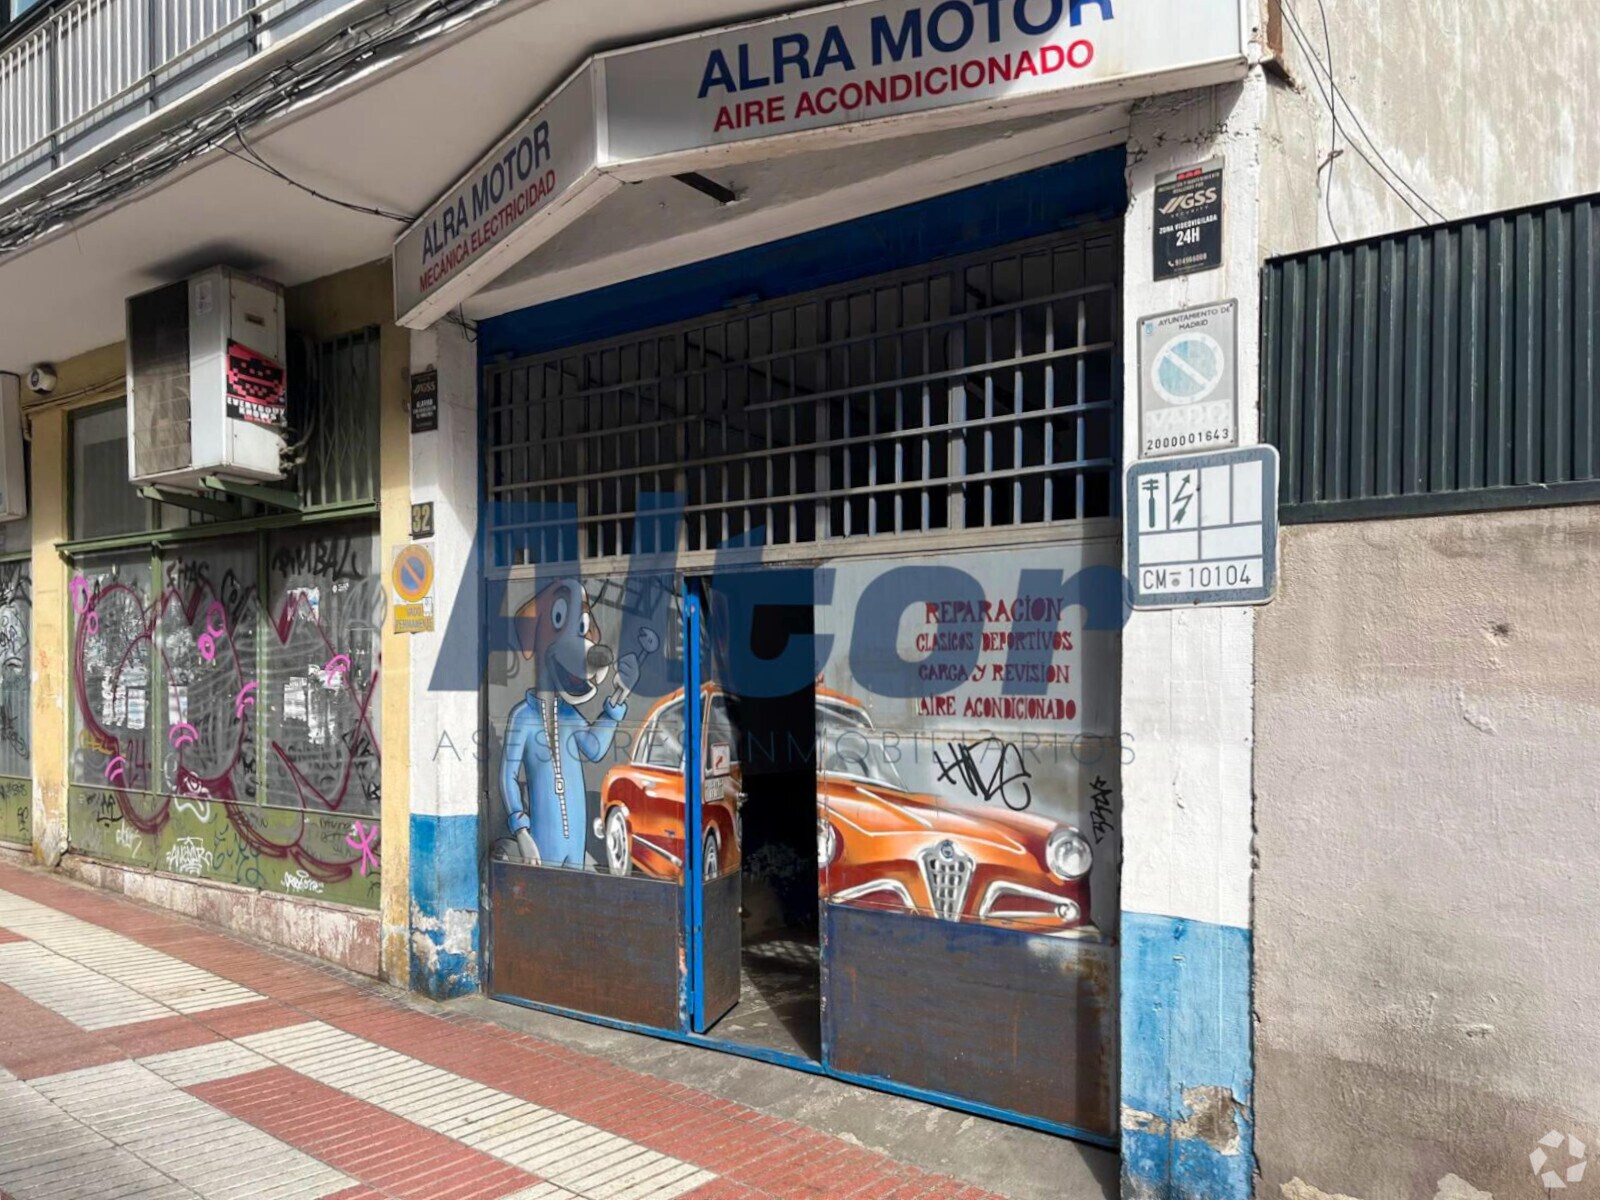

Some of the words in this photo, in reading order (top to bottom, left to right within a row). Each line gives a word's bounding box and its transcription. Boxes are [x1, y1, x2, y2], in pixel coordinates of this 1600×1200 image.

[697, 25, 855, 99] ALRA
[869, 0, 1114, 66] MOTOR
[713, 97, 785, 133] AIRE
[793, 39, 1095, 118] ACONDICIONADO
[422, 197, 469, 265] ALRA
[471, 119, 551, 222] MOTOR
[470, 169, 557, 253] ELECTRICIDAD
[1176, 226, 1200, 246] 24H
[1158, 308, 1219, 326] AYUNTAMIENTO
[1220, 305, 1230, 314] DE
[1178, 318, 1209, 330] MADRID
[1147, 428, 1230, 451] 2000001643
[412, 504, 431, 533] 32
[915, 631, 974, 652] CLASICOS
[918, 663, 969, 682] CARGA
[917, 693, 957, 717] AIRE
[963, 696, 1077, 721] ACONDICIONADO
